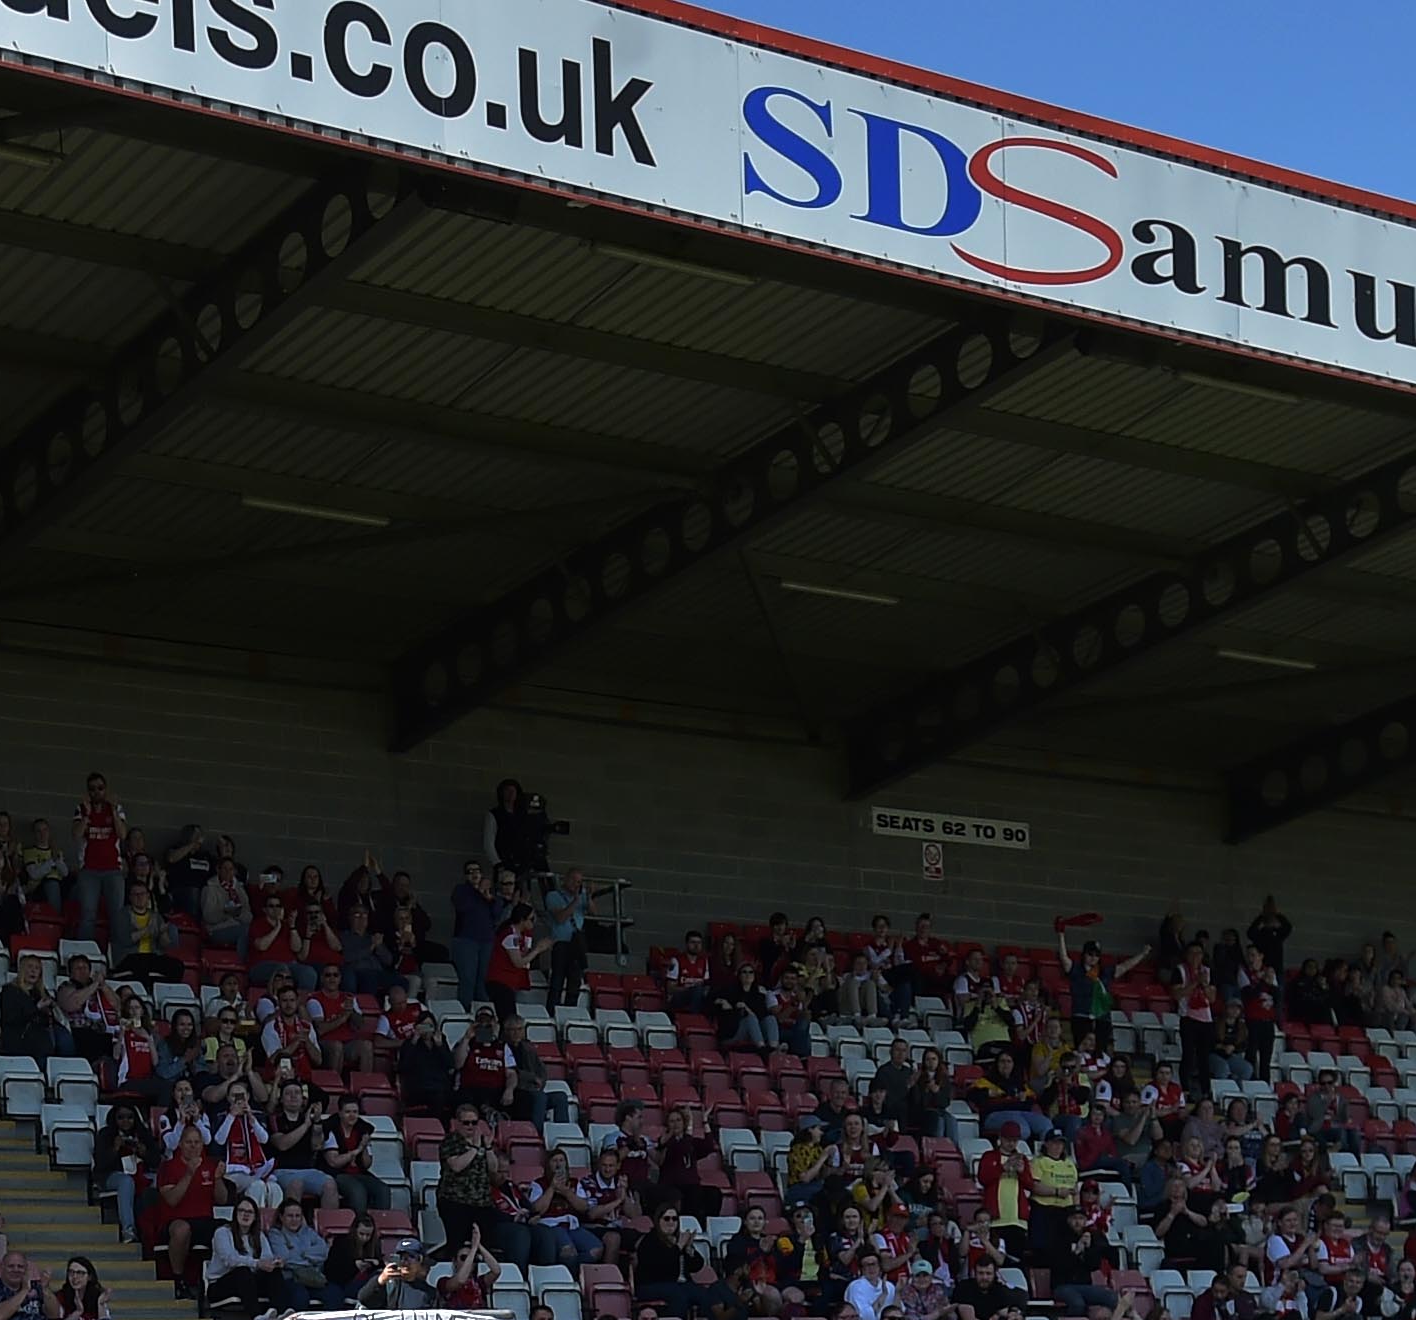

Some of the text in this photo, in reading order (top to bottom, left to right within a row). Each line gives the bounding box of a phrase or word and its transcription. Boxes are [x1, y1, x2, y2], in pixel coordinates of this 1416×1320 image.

[877, 814, 1026, 842] SEATS 62 TO 90
